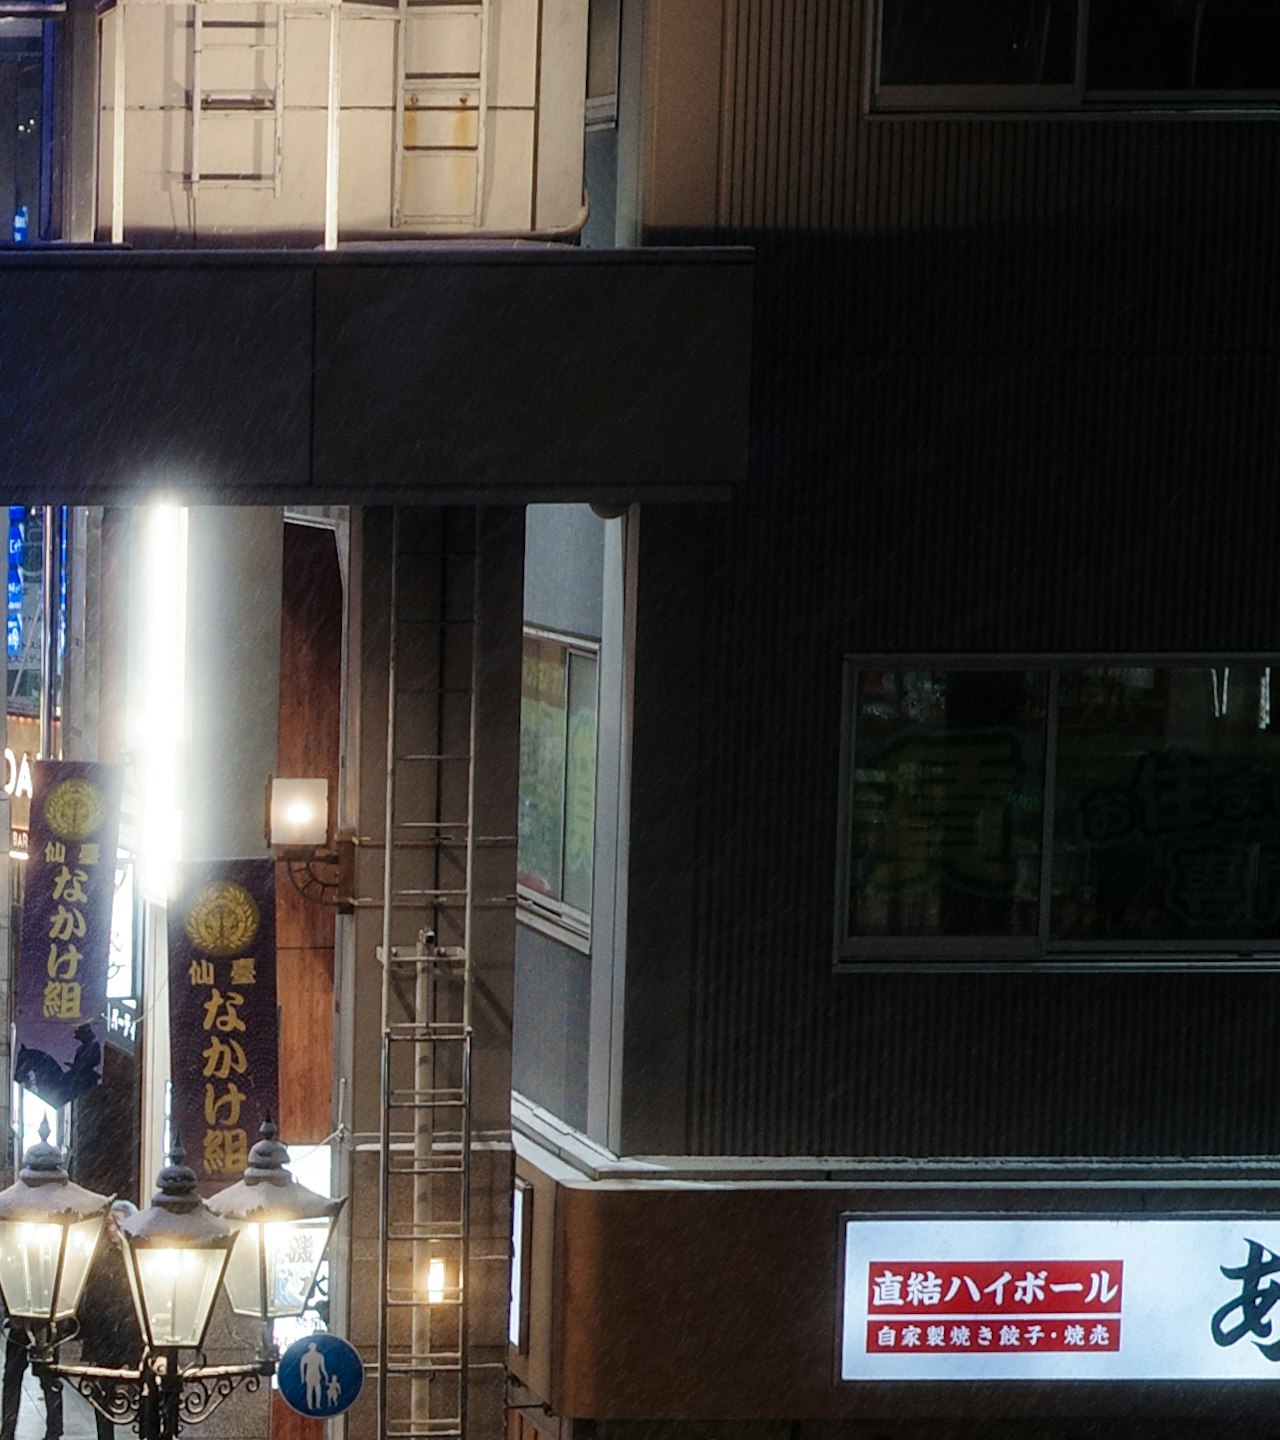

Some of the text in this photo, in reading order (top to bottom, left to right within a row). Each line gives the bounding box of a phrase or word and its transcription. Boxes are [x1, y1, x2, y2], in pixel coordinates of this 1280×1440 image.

[12, 829, 29, 851] BAR
[43, 864, 90, 1020] なかけ組
[202, 987, 249, 1175] なかけ組
[871, 1269, 1121, 1308] 直結ハイボール
[875, 1323, 1112, 1349] 自家製焼き餃子・焼売
